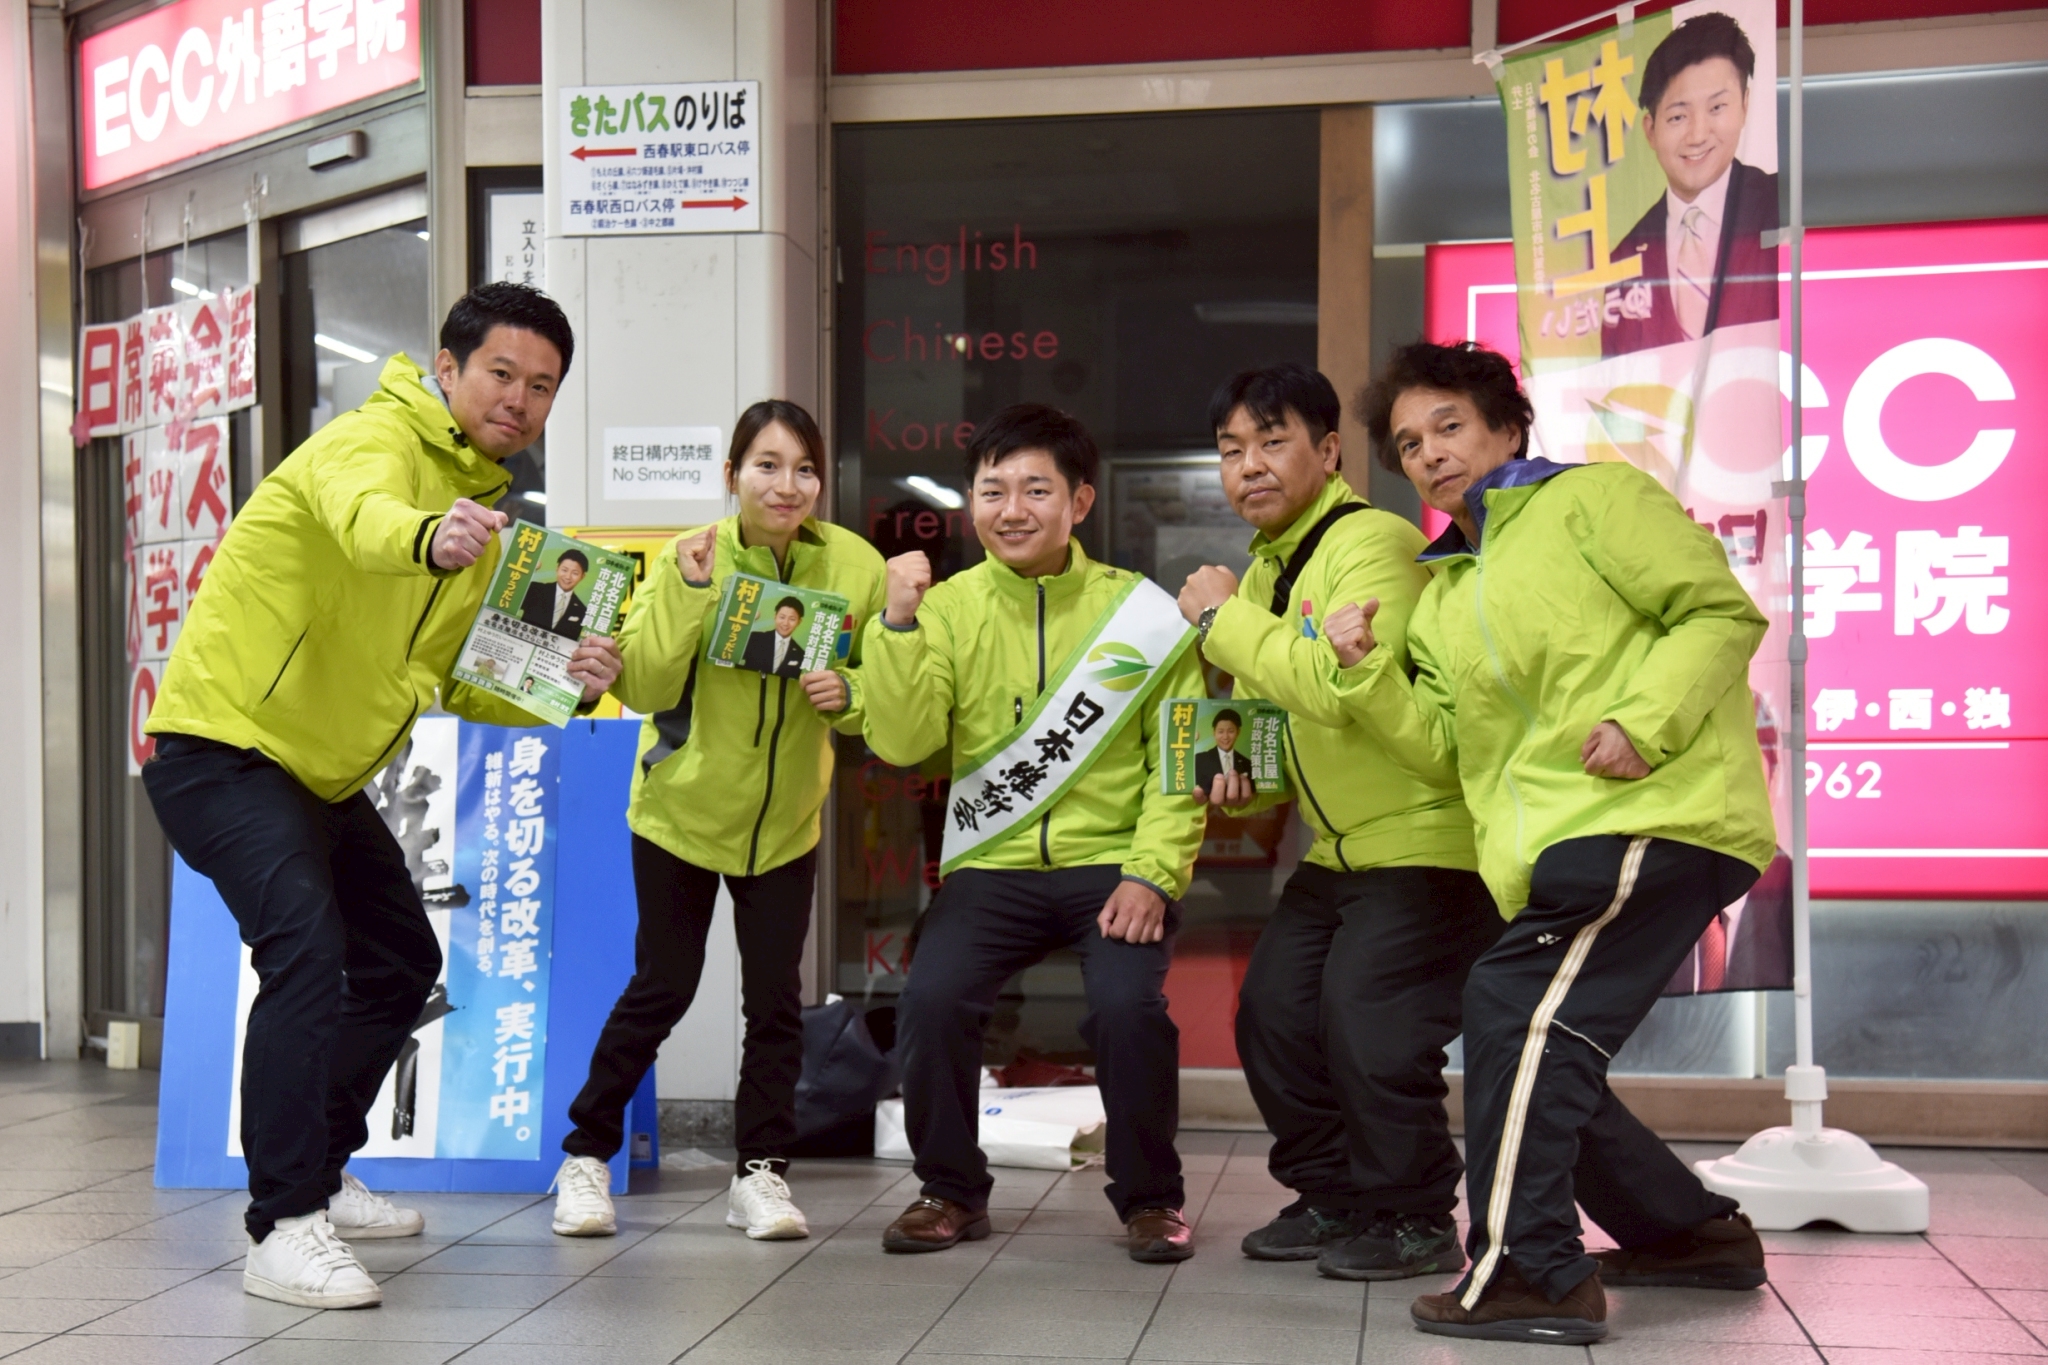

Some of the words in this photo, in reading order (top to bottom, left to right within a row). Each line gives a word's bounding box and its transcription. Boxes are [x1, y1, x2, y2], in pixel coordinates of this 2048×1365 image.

[94, 0, 407, 158] ECC外語学院
[570, 88, 747, 137] きたバスのりば
[643, 140, 750, 159] 西春駅東口バス停
[570, 198, 675, 214] 西春駅西口バス停
[505, 255, 514, 282] EC
[865, 224, 1037, 286] English
[862, 318, 1059, 364] Chinese
[612, 444, 713, 461] 終日構内禁煙
[868, 408, 976, 451] Kore
[126, 423, 228, 540] キッズ
[613, 467, 634, 481] No
[638, 466, 701, 485] Smoking
[868, 497, 973, 539] Fren
[499, 526, 543, 609] 村上ゆうだい
[1770, 526, 2011, 638] 学院
[595, 571, 626, 634] 北名古屋
[721, 580, 760, 660] 村上ゆうだい
[538, 649, 567, 666] 村上ゆうだ
[813, 613, 840, 672] 北名古屋
[953, 691, 1104, 832] 日本維新の会
[1170, 704, 1193, 791] 村上ゆうだい
[1264, 717, 1280, 779] 北名古屋
[857, 759, 949, 800] Ger
[1804, 761, 1882, 799] 962
[476, 751, 504, 979] 維新はやる。次の時代を創る。
[864, 848, 946, 890] We
[489, 735, 549, 1142] 身を切る改革、実行中。
[867, 932, 910, 975] Ki
